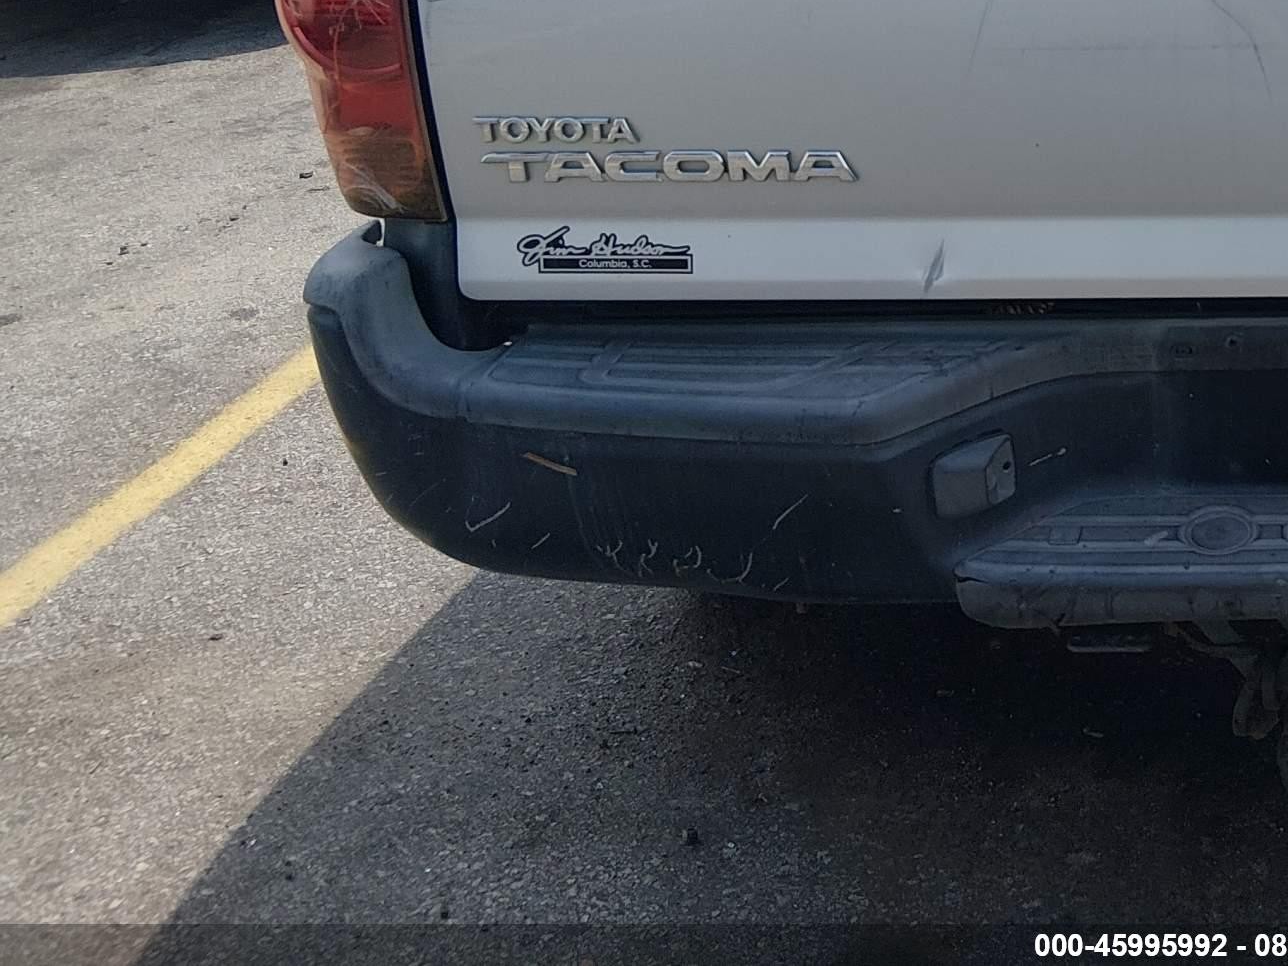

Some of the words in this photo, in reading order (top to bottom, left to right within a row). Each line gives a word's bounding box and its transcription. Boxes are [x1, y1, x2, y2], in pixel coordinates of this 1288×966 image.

[472, 115, 640, 144] TOYOTA
[480, 149, 860, 183] TACOMA
[517, 226, 588, 266] Jim
[589, 233, 691, 257] Hudson
[578, 259, 631, 269] Columbia,
[632, 259, 653, 269] S.C.
